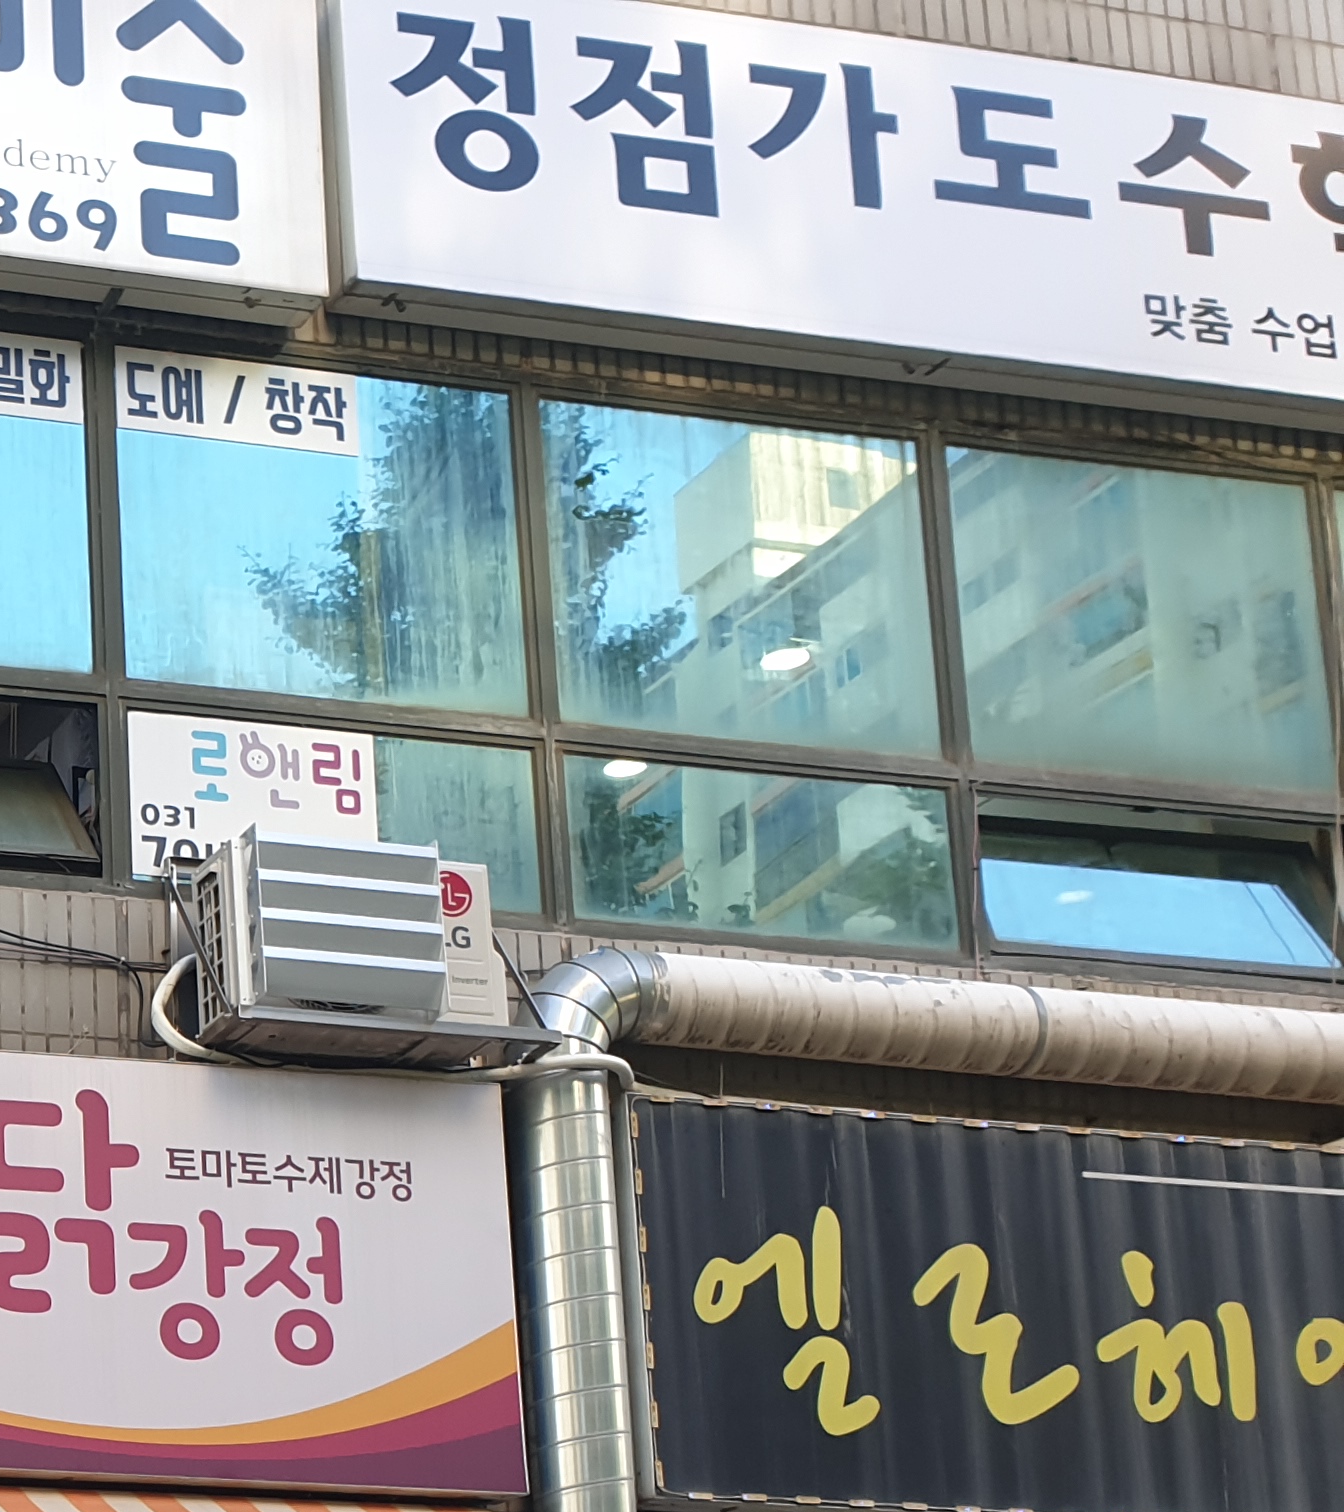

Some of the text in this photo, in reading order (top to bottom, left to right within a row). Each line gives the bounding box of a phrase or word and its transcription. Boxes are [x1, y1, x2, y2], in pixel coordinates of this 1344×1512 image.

[1143, 293, 1338, 359] 맞춤 수업
[125, 362, 205, 425] 도예
[262, 375, 349, 444] 창작
[139, 802, 197, 831] 031
[450, 975, 489, 987] Inverter
[164, 1140, 413, 1205] 토마토수제강정
